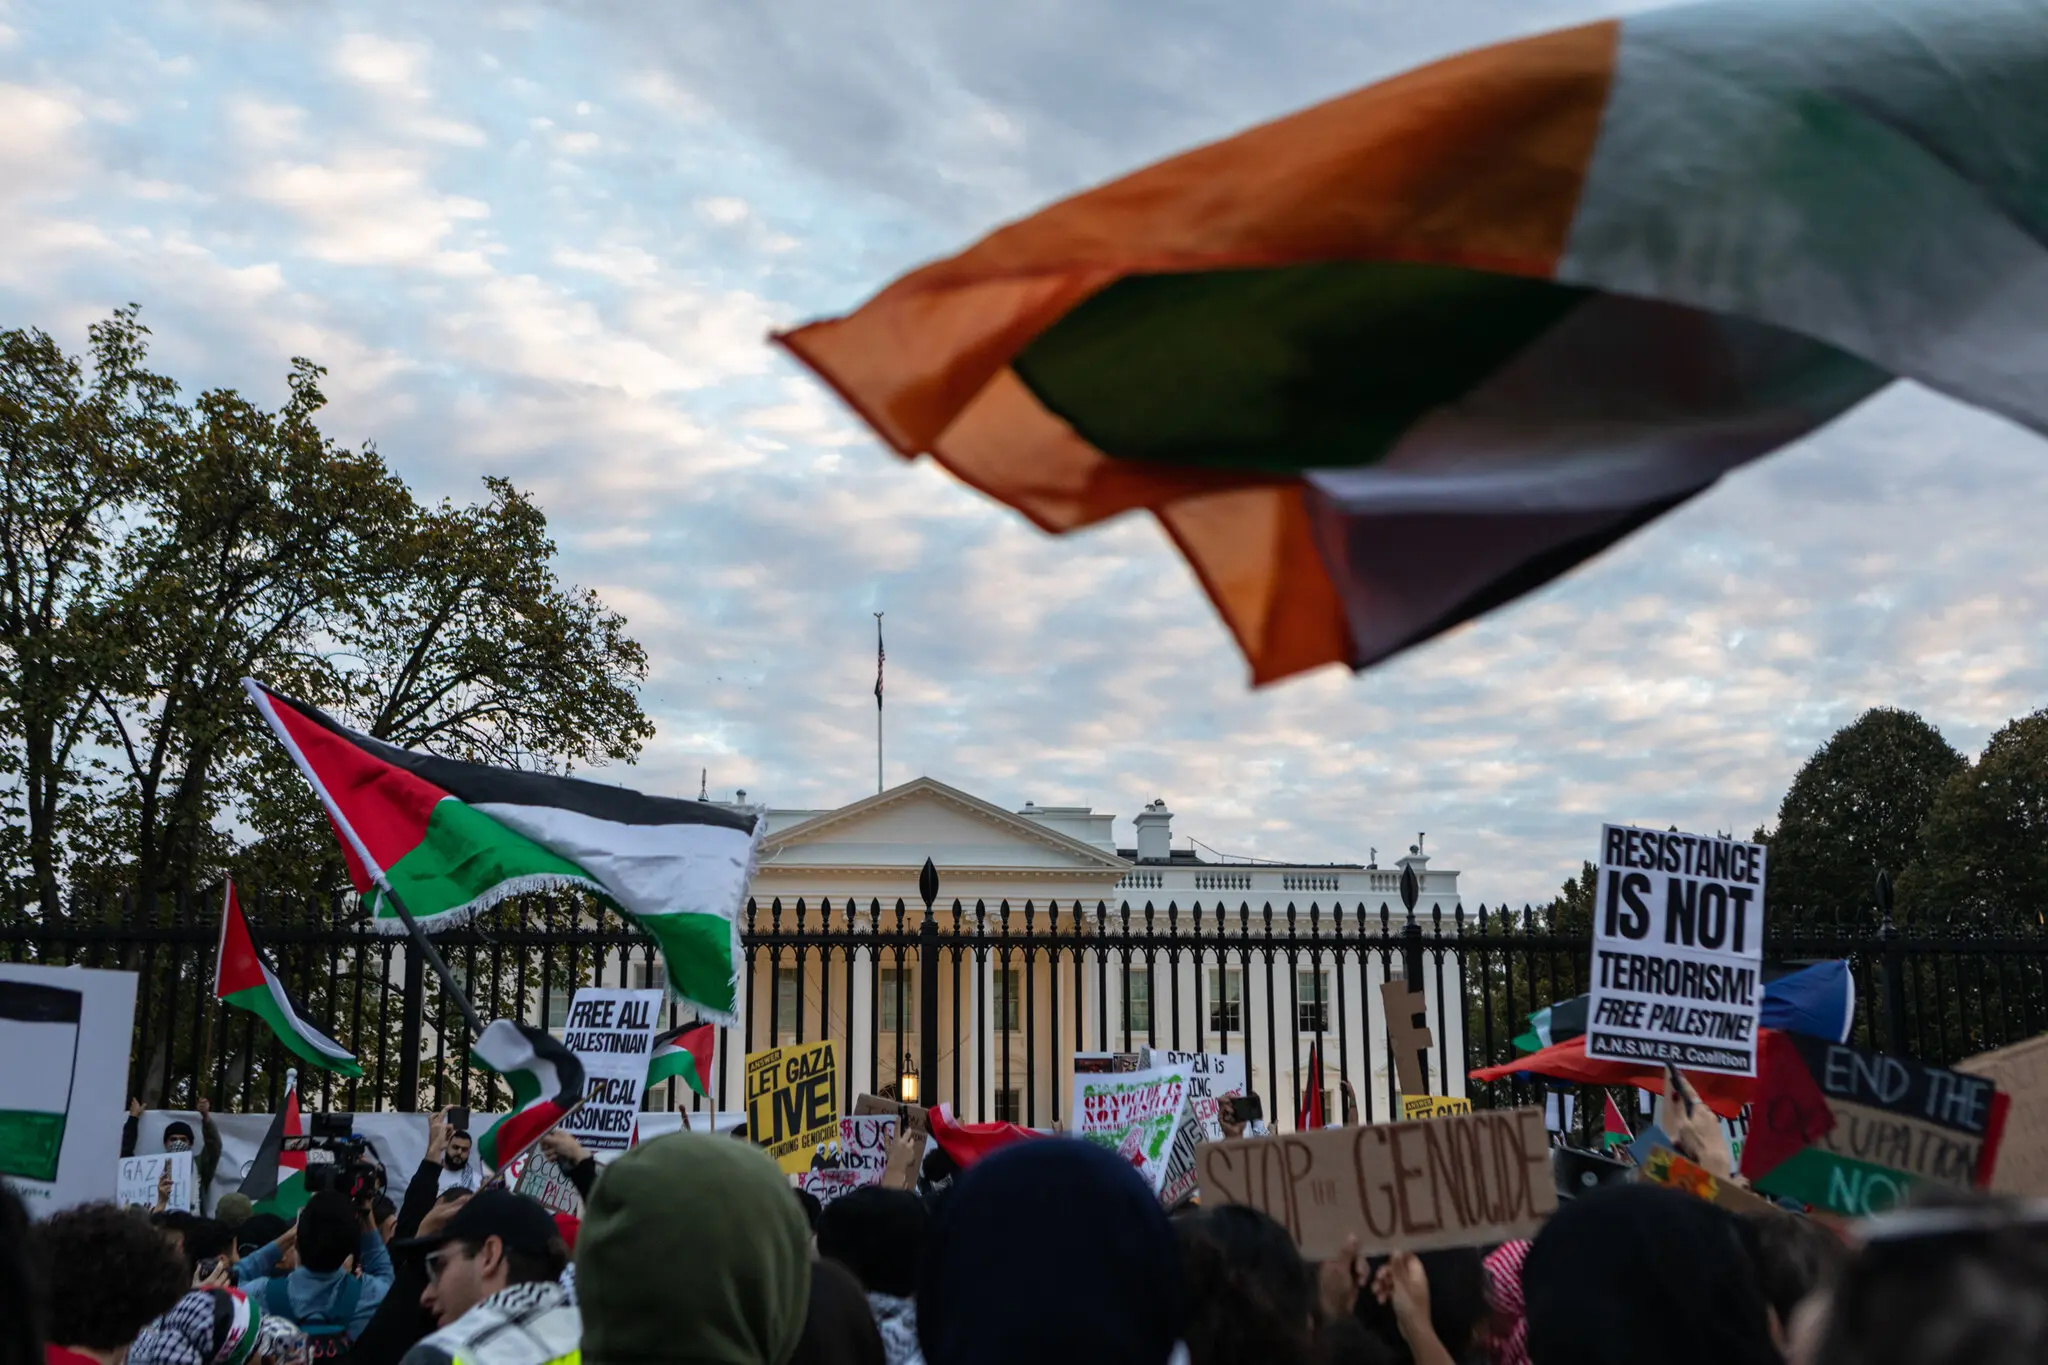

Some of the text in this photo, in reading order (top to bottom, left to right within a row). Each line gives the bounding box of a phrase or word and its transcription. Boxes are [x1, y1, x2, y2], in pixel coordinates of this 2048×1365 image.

[1605, 827, 1760, 884] RESISTANCE
[1605, 870, 1754, 953] IS NOT
[1598, 950, 1755, 1007] TERRORISM!
[569, 1000, 650, 1029] FREE ALL
[1594, 997, 1754, 1042] FREE PALESTINE!
[564, 1032, 648, 1054] PALESTINIAN
[750, 1050, 780, 1072] ANSWER
[1214, 1058, 1224, 1074] is
[1596, 1036, 1748, 1068] A.N.S.W.E.R. Coalition
[749, 1044, 835, 1099] LET GAZA
[1825, 1046, 1911, 1103] END
[1922, 1066, 1990, 1131] THE
[559, 1106, 633, 1132] RISONERS
[749, 1070, 837, 1147] LIVE!
[1084, 1110, 1120, 1124] NOT
[1206, 1138, 1312, 1245] STOP
[1353, 1109, 1550, 1239] GENOCIDE
[1828, 1164, 1911, 1220] NO
